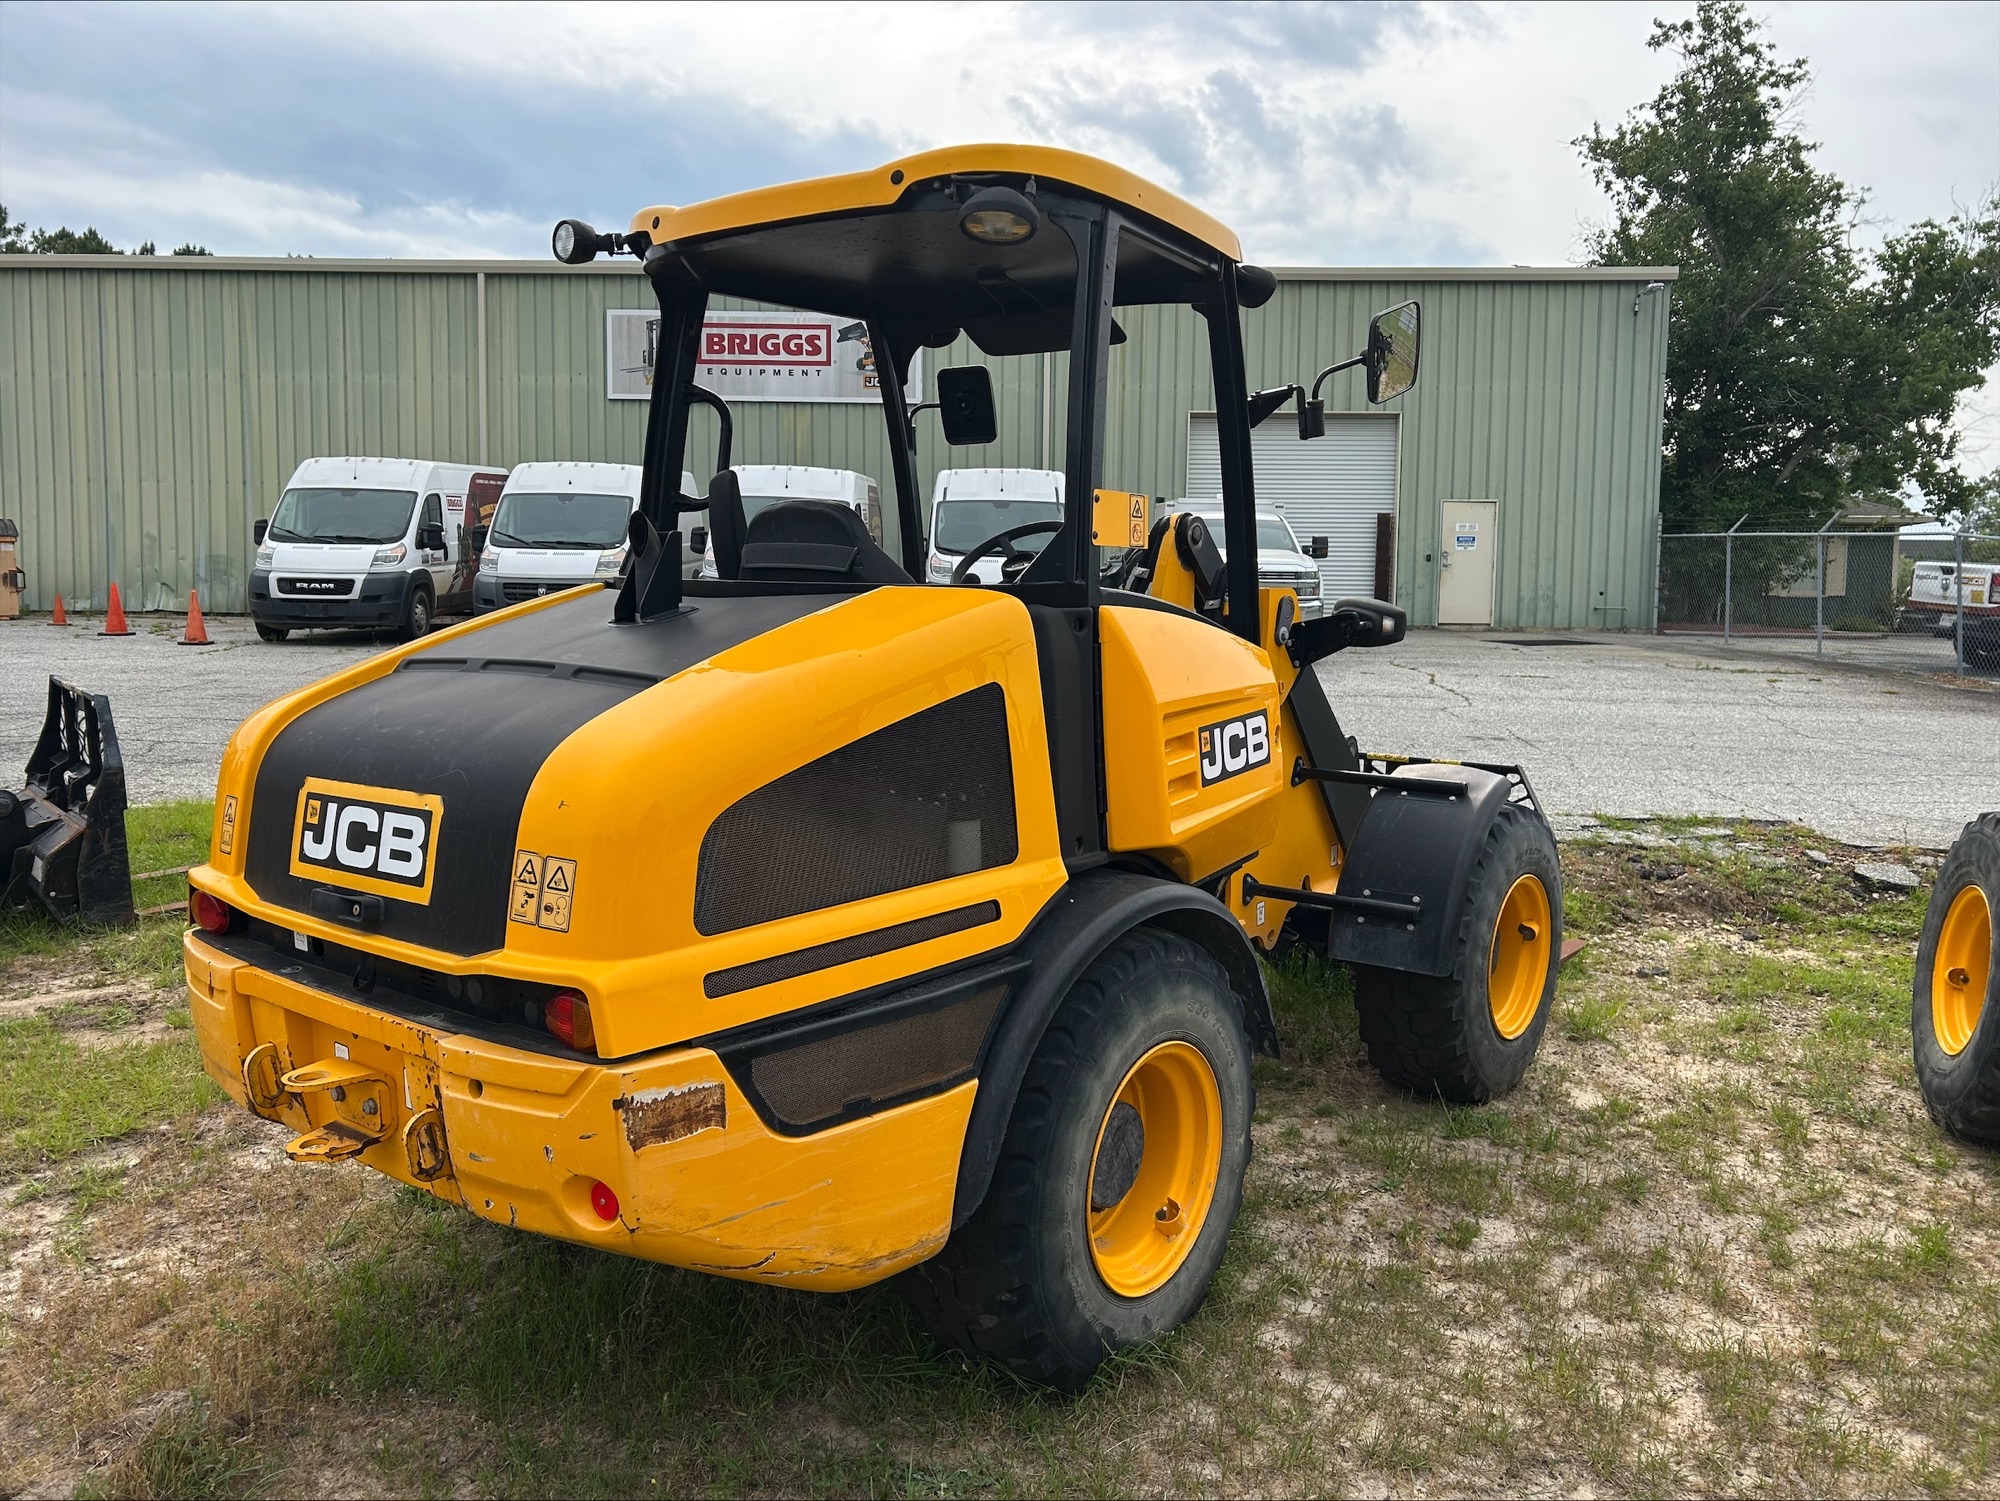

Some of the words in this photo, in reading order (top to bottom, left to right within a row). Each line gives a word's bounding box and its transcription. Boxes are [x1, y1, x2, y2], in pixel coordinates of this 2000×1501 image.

[705, 332, 822, 356] BRIGGS
[707, 367, 822, 377] EQUIPMENT
[865, 377, 881, 387] JC
[1202, 715, 1269, 780] JCB
[303, 802, 426, 878] JCB
